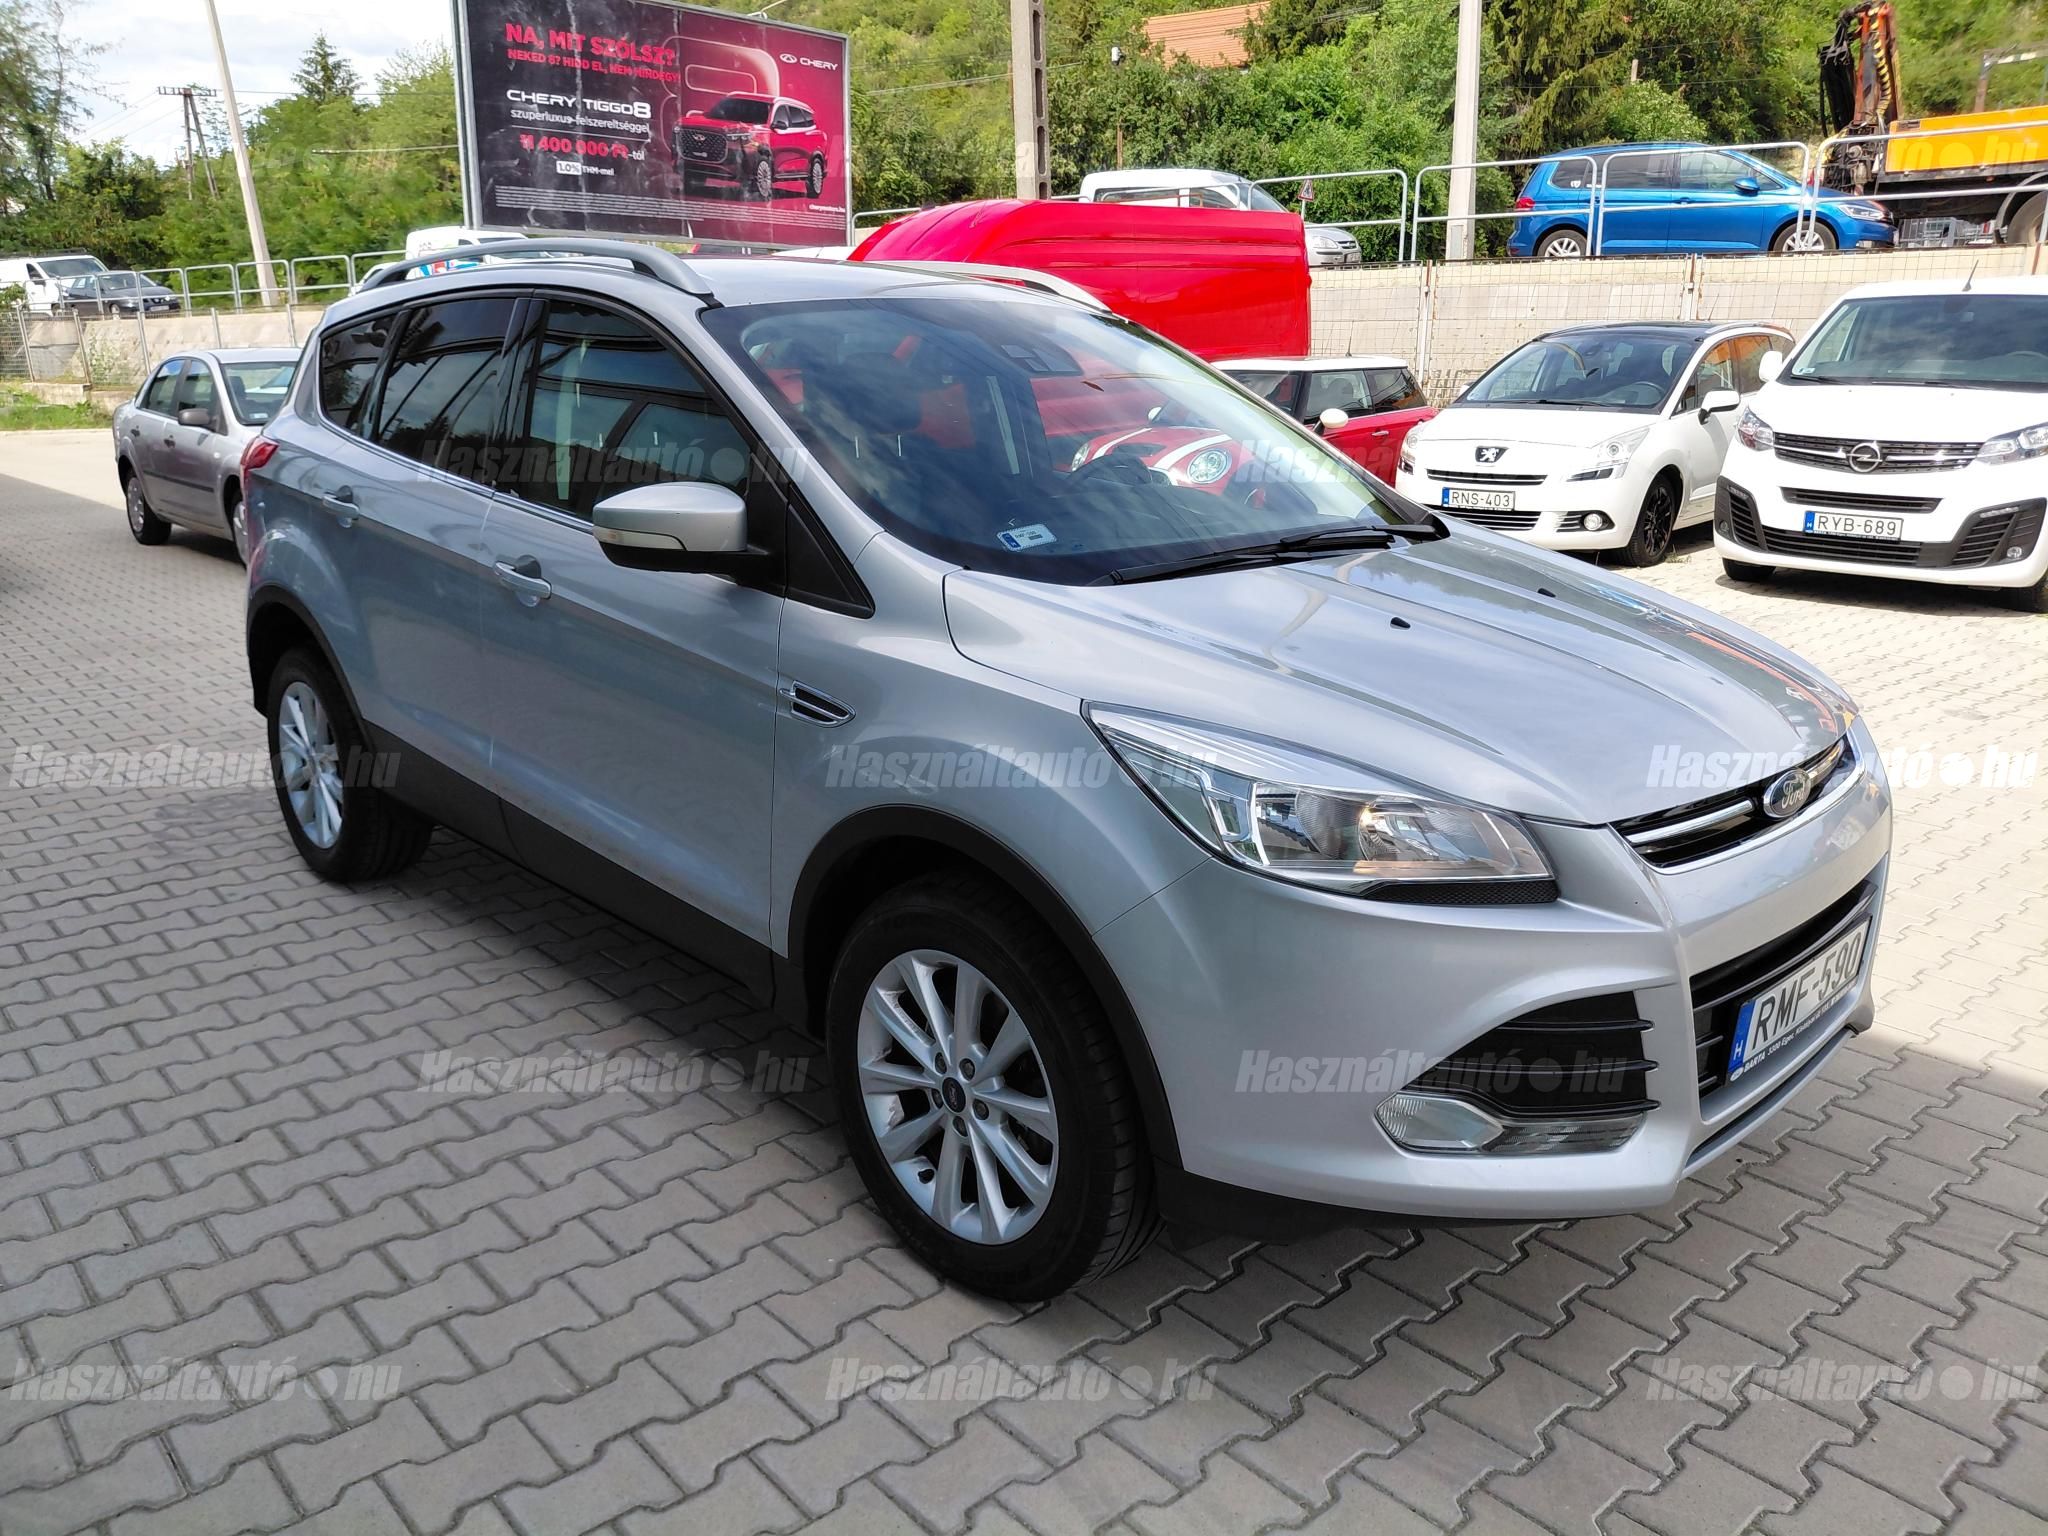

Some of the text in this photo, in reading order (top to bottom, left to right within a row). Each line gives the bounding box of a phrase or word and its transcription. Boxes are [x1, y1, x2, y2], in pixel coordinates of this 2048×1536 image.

[505, 23, 676, 66] NA, MIT SZÓLSZ?
[507, 48, 546, 63] NEKED
[800, 57, 839, 71] CHERY
[506, 89, 577, 108] CHERY
[537, 136, 572, 153] 400
[575, 140, 609, 157] 000
[1451, 491, 1510, 507] RNS-403
[1817, 515, 1897, 536] RYB-689
[1733, 931, 1862, 1061] H RMF-590
